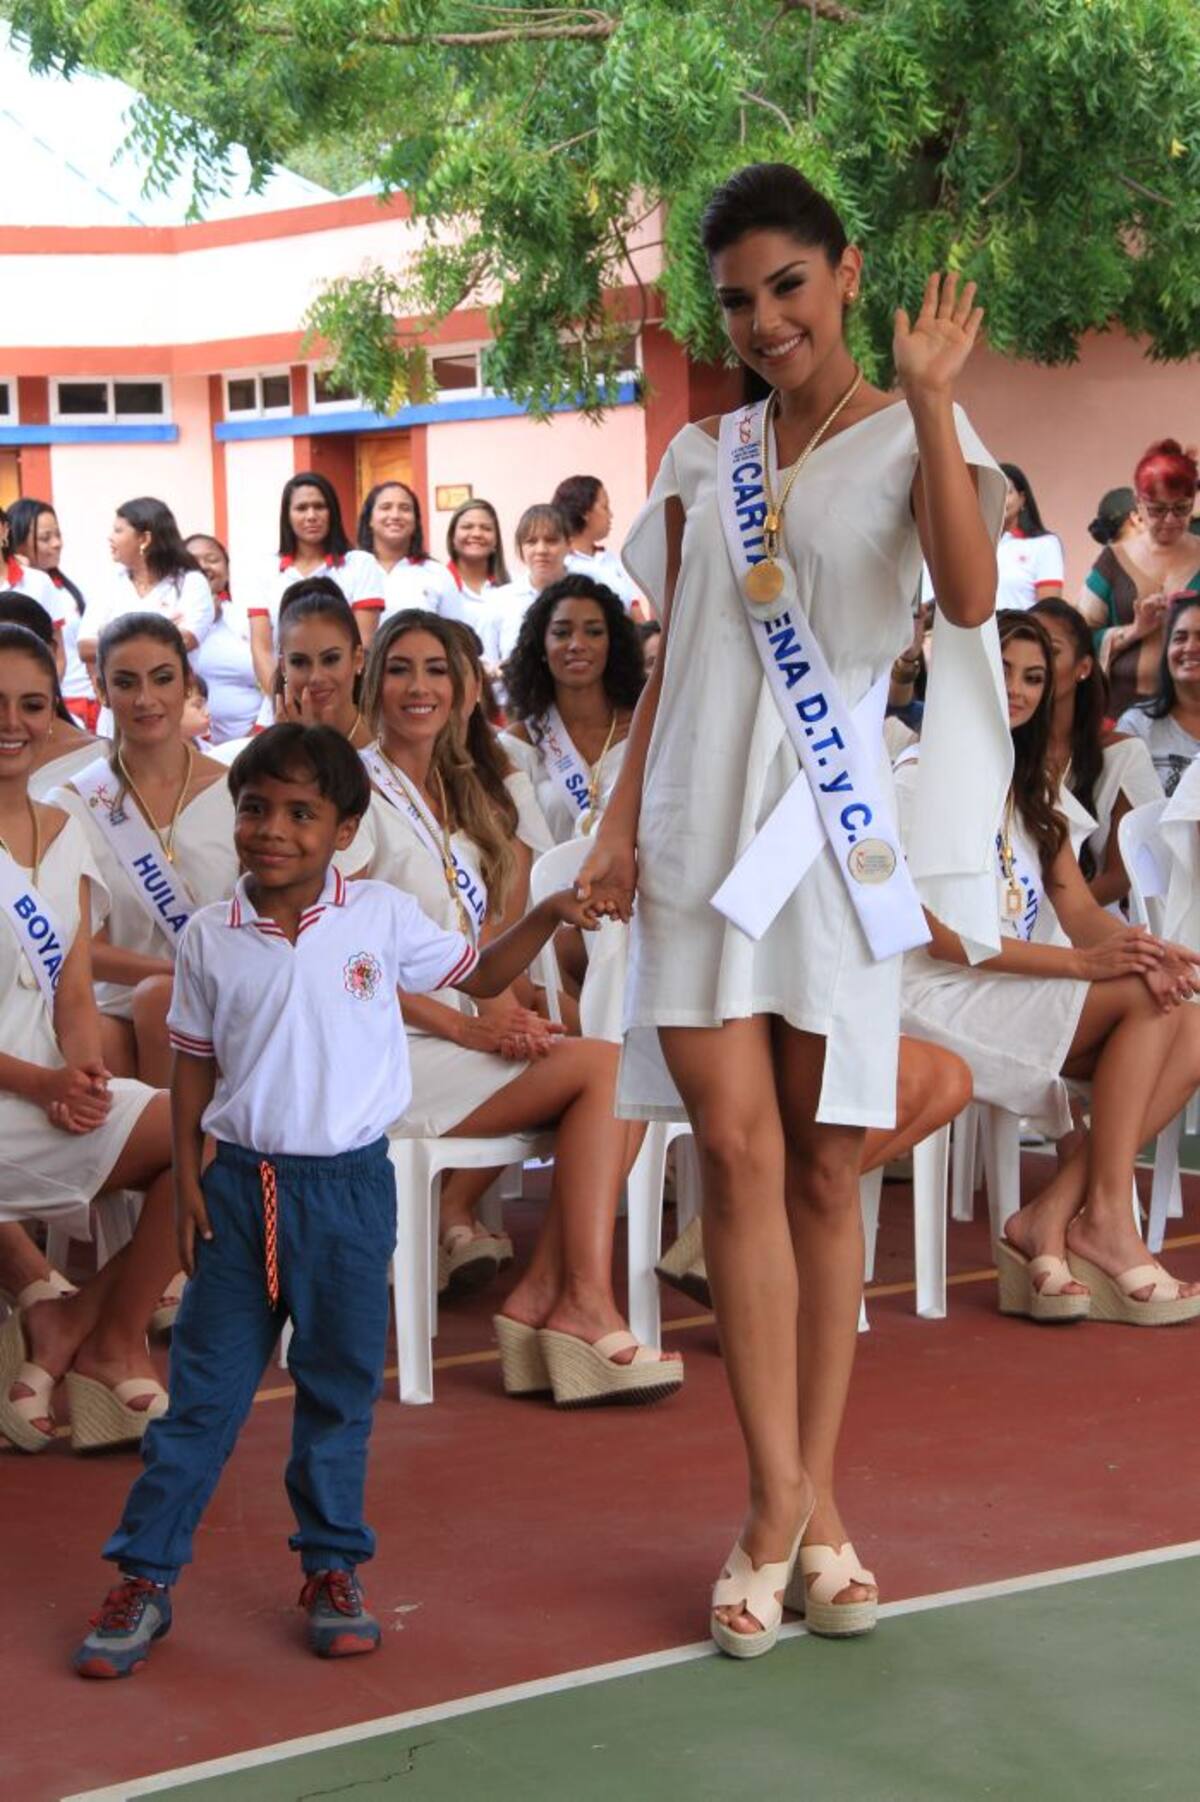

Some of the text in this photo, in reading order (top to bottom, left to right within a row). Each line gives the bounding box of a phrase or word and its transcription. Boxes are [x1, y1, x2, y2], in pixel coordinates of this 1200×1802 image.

[732, 462, 811, 690] CARTENA
[795, 692, 845, 767] D.T.
[819, 771, 854, 793] y
[840, 803, 873, 843] C.
[132, 853, 189, 934] HUILA
